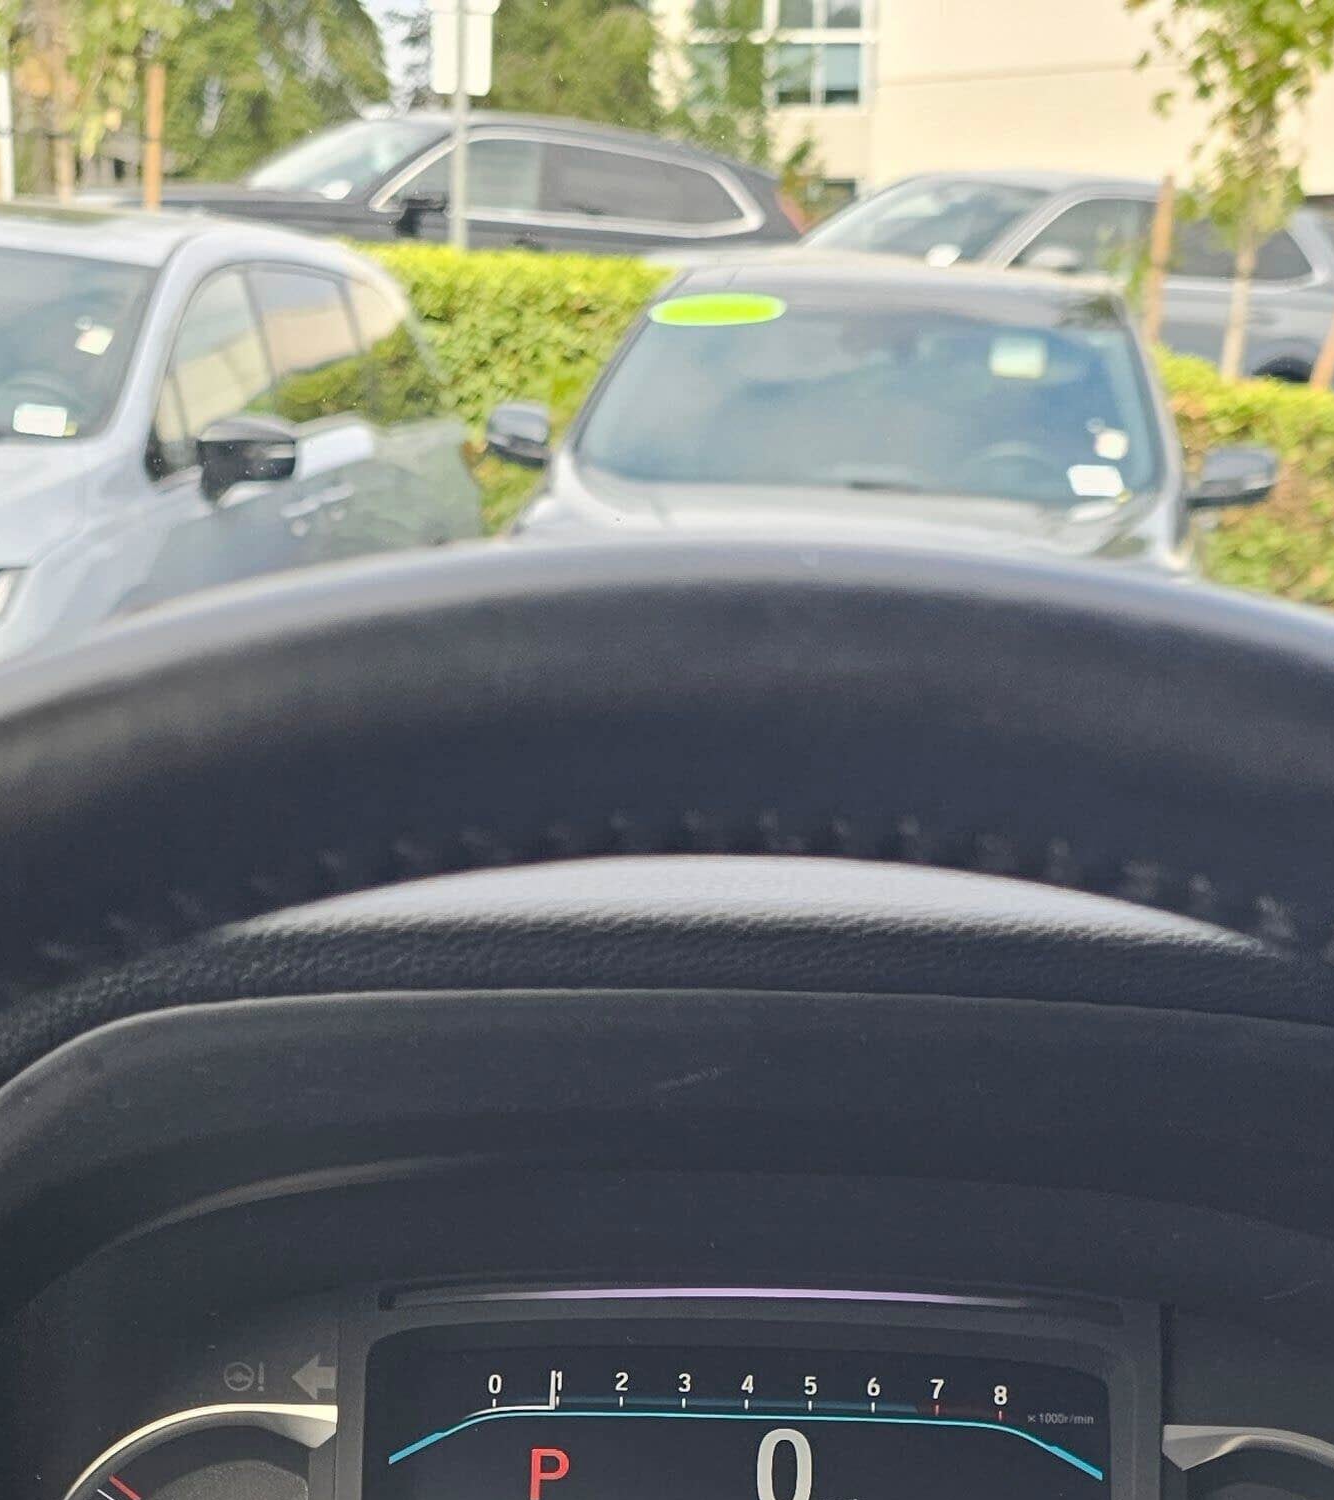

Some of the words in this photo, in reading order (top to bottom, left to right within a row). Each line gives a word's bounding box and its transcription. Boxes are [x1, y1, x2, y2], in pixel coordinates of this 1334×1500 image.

[488, 1374, 502, 1394] 0
[615, 1372, 629, 1391] 2
[678, 1373, 691, 1393] 3
[741, 1374, 754, 1394] 4
[804, 1376, 817, 1395] 5
[867, 1377, 881, 1397] 6
[930, 1378, 945, 1400] 7
[993, 1385, 1008, 1406] 8
